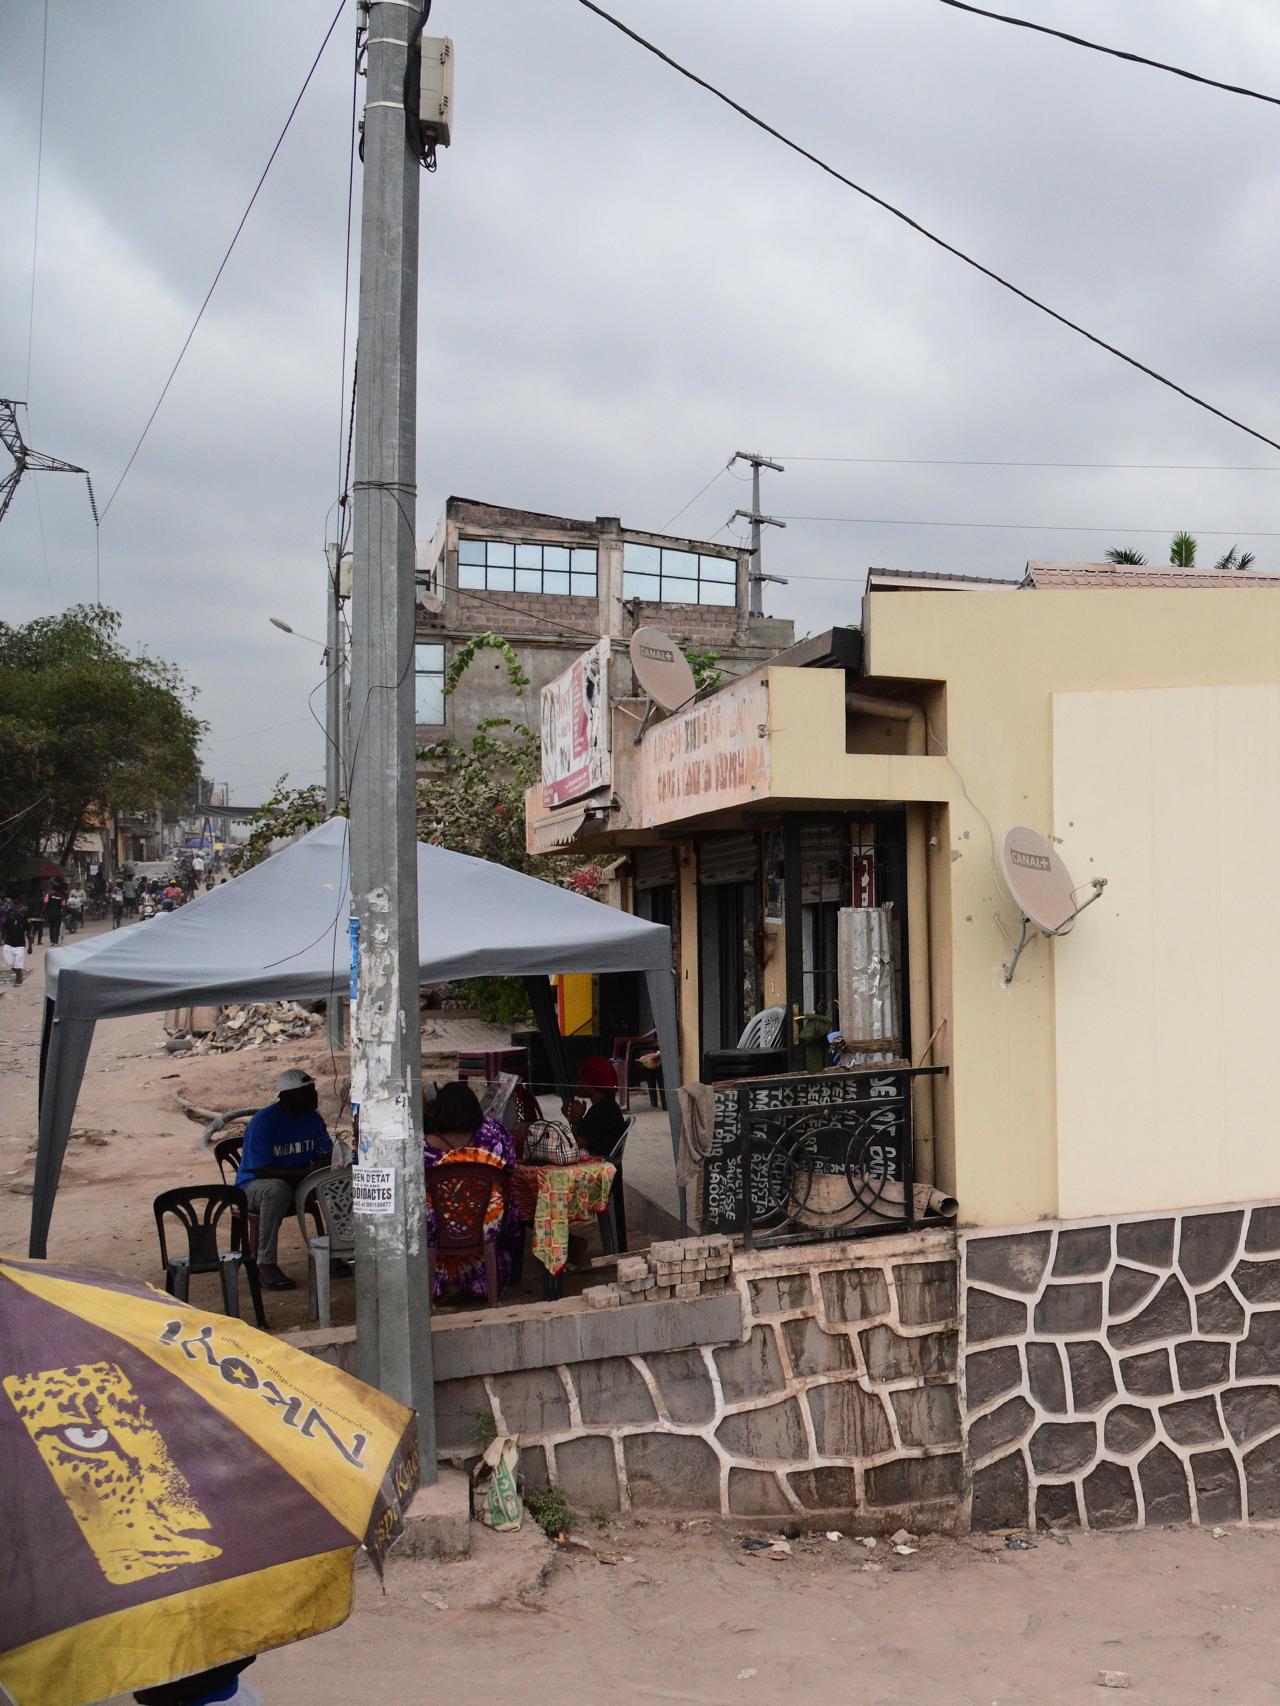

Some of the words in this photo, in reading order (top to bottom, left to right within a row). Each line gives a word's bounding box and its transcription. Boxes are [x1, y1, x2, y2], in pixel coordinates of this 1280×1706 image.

[640, 646, 673, 662] CANAL+
[1010, 850, 1050, 870] CANAL+
[723, 1090, 739, 1143] FANTA
[752, 1089, 770, 1139] MATA
[366, 1173, 391, 1184] D'ETAT
[725, 1158, 736, 1221] SAUCISSE
